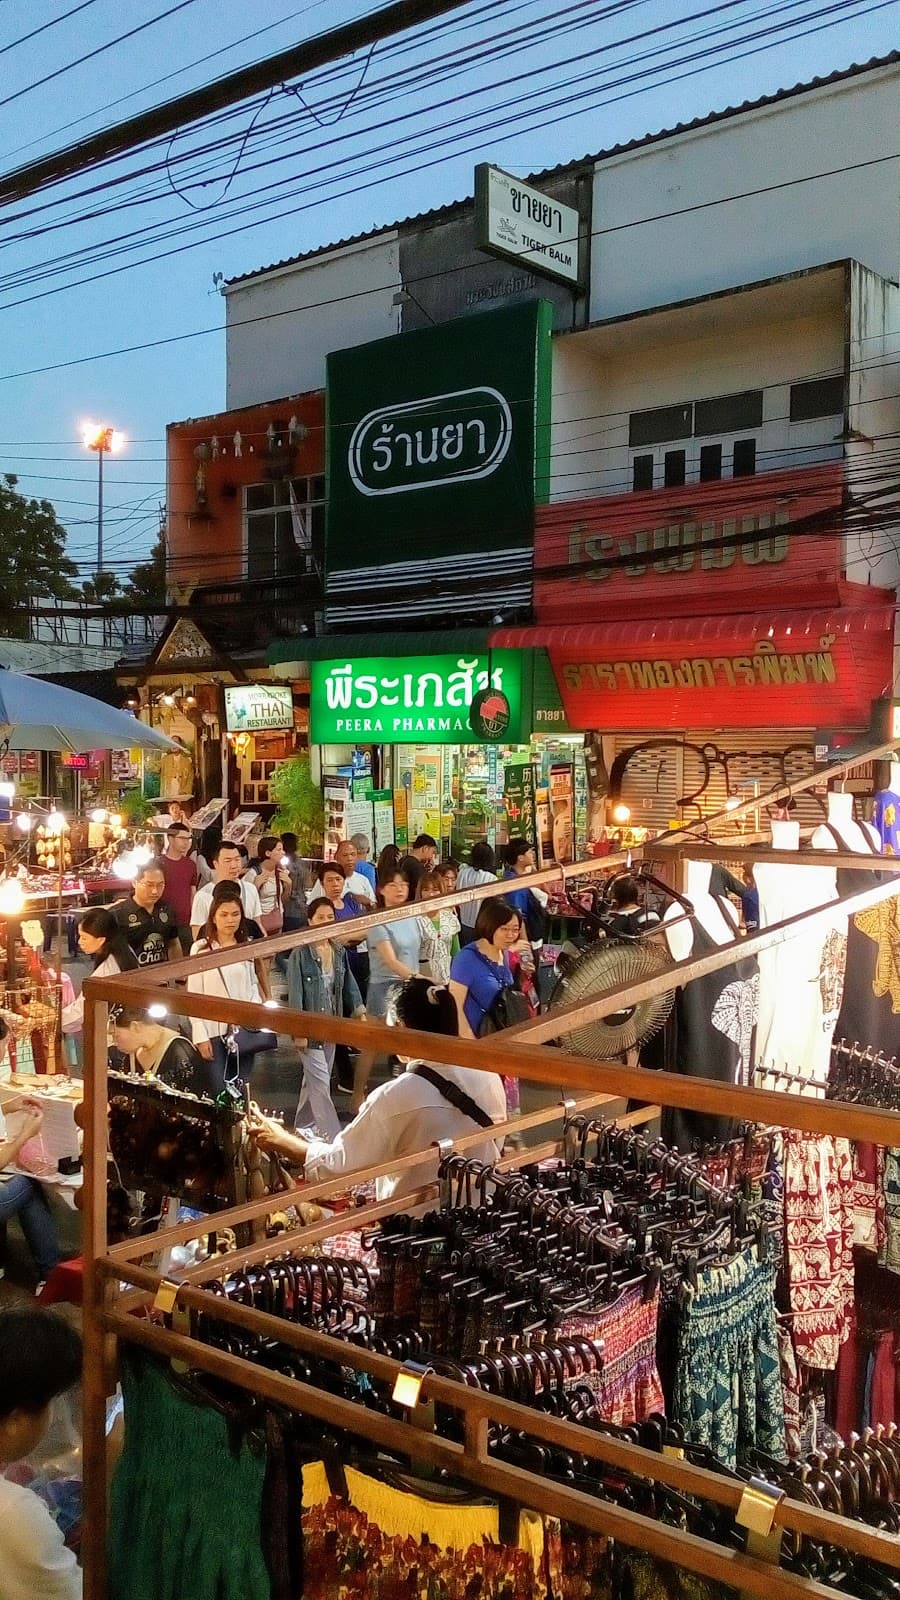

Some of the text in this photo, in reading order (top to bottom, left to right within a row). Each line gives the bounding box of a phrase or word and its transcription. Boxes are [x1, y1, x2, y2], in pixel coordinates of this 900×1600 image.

[510, 188, 562, 233] ขายยา
[521, 234, 572, 267] TIGER BALM
[372, 419, 486, 472] ร้านยา
[250, 702, 285, 718] THAI
[247, 717, 291, 728] RESTAURANT
[335, 717, 473, 732] PEERA PHARMAC
